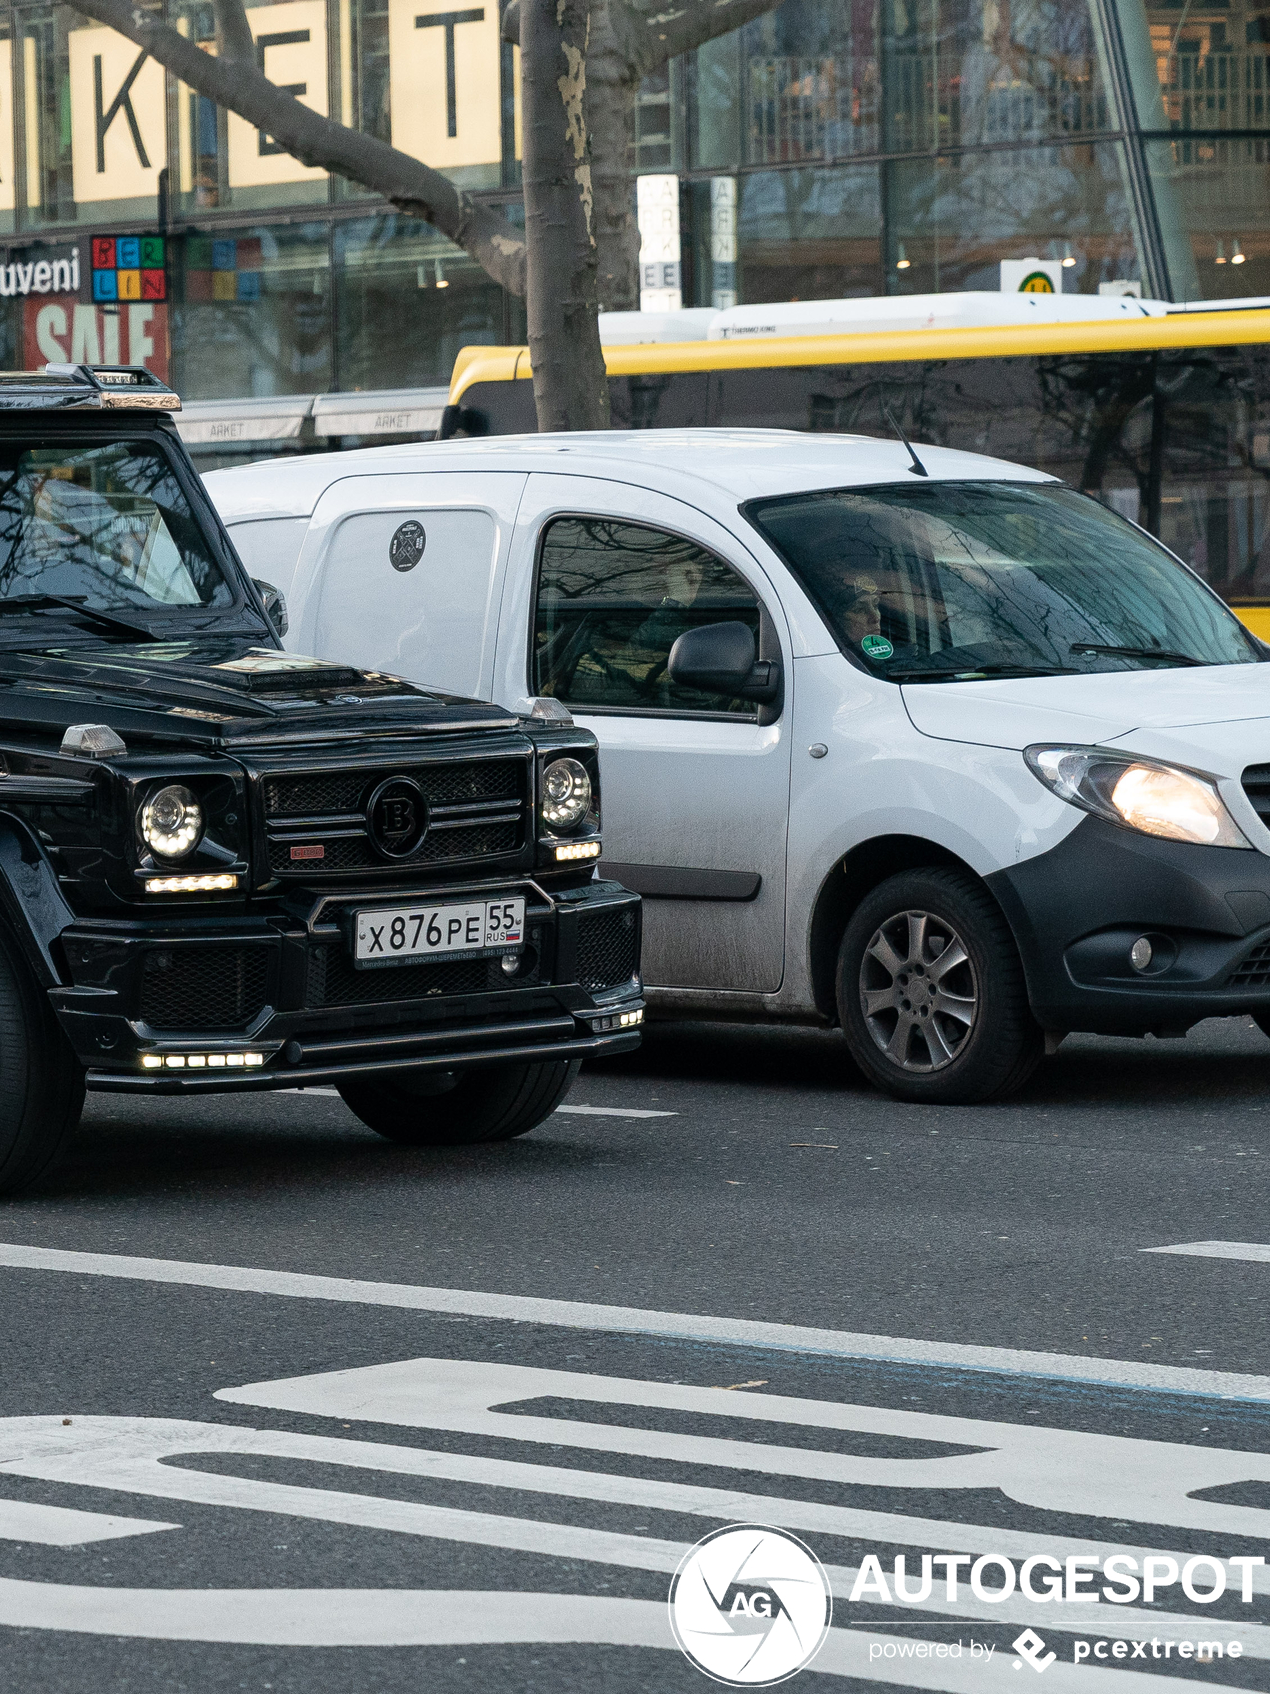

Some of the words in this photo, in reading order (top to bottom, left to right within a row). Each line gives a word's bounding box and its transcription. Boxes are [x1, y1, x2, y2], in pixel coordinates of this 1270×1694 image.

[732, 326, 759, 334] THERMO
[375, 413, 412, 429] ARKET
[210, 422, 244, 437] ARKET
[488, 904, 515, 931] 55
[486, 932, 506, 942] RUS
